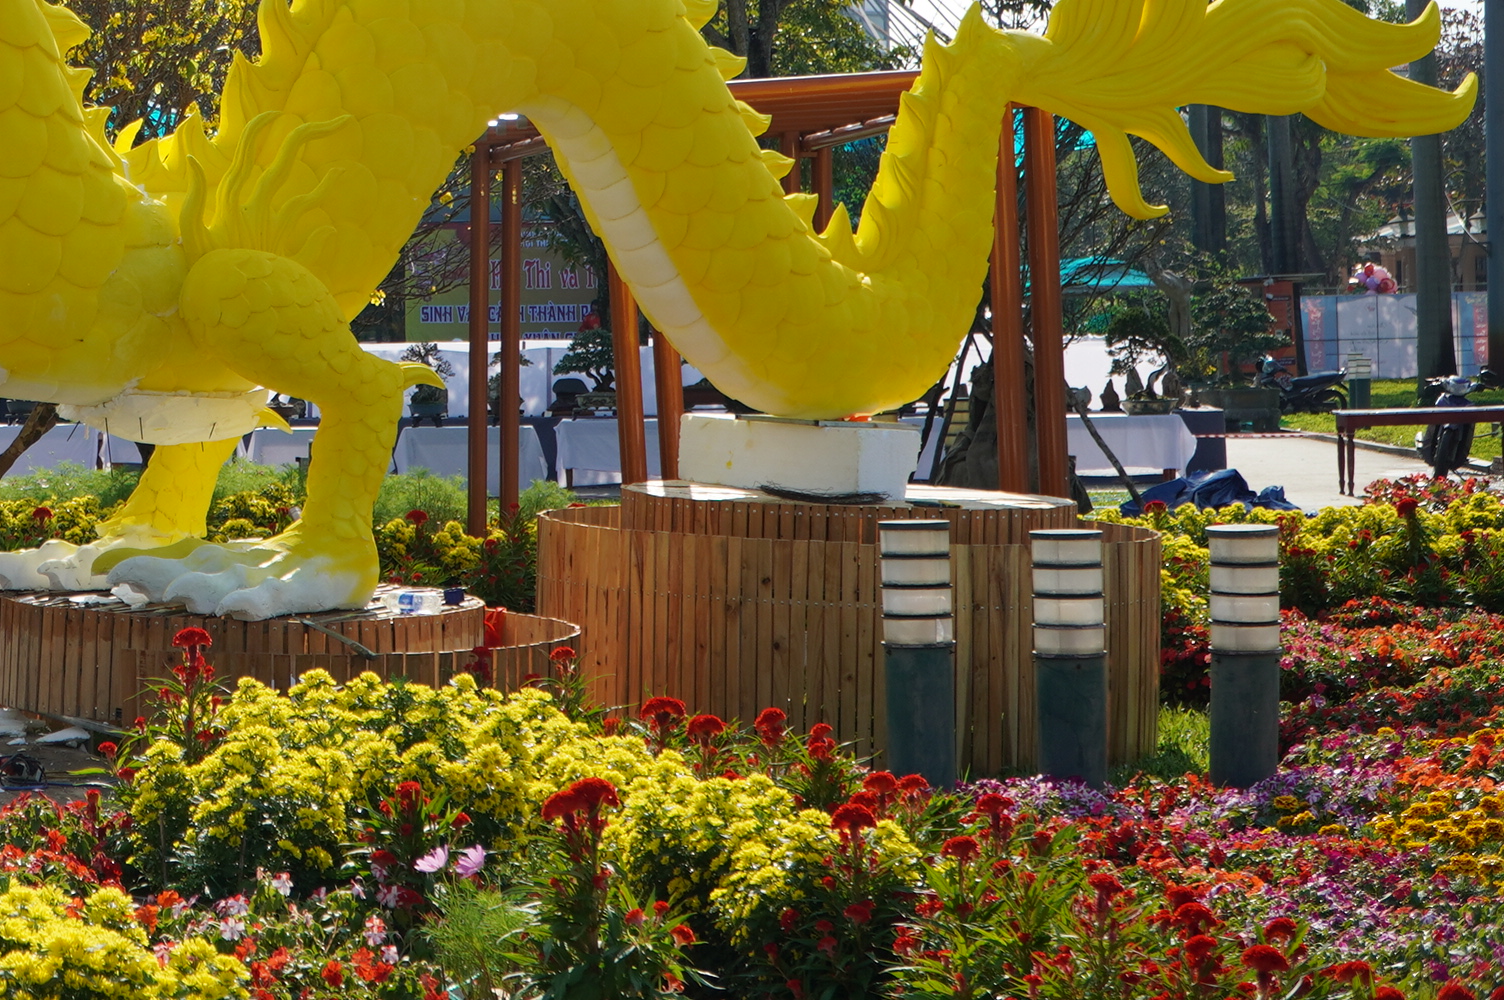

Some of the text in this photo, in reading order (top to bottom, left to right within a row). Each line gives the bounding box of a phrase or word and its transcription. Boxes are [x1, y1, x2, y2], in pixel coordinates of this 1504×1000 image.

[523, 258, 552, 289] Thi
[420, 304, 454, 323] SINH
[528, 300, 577, 323] THÀNH
